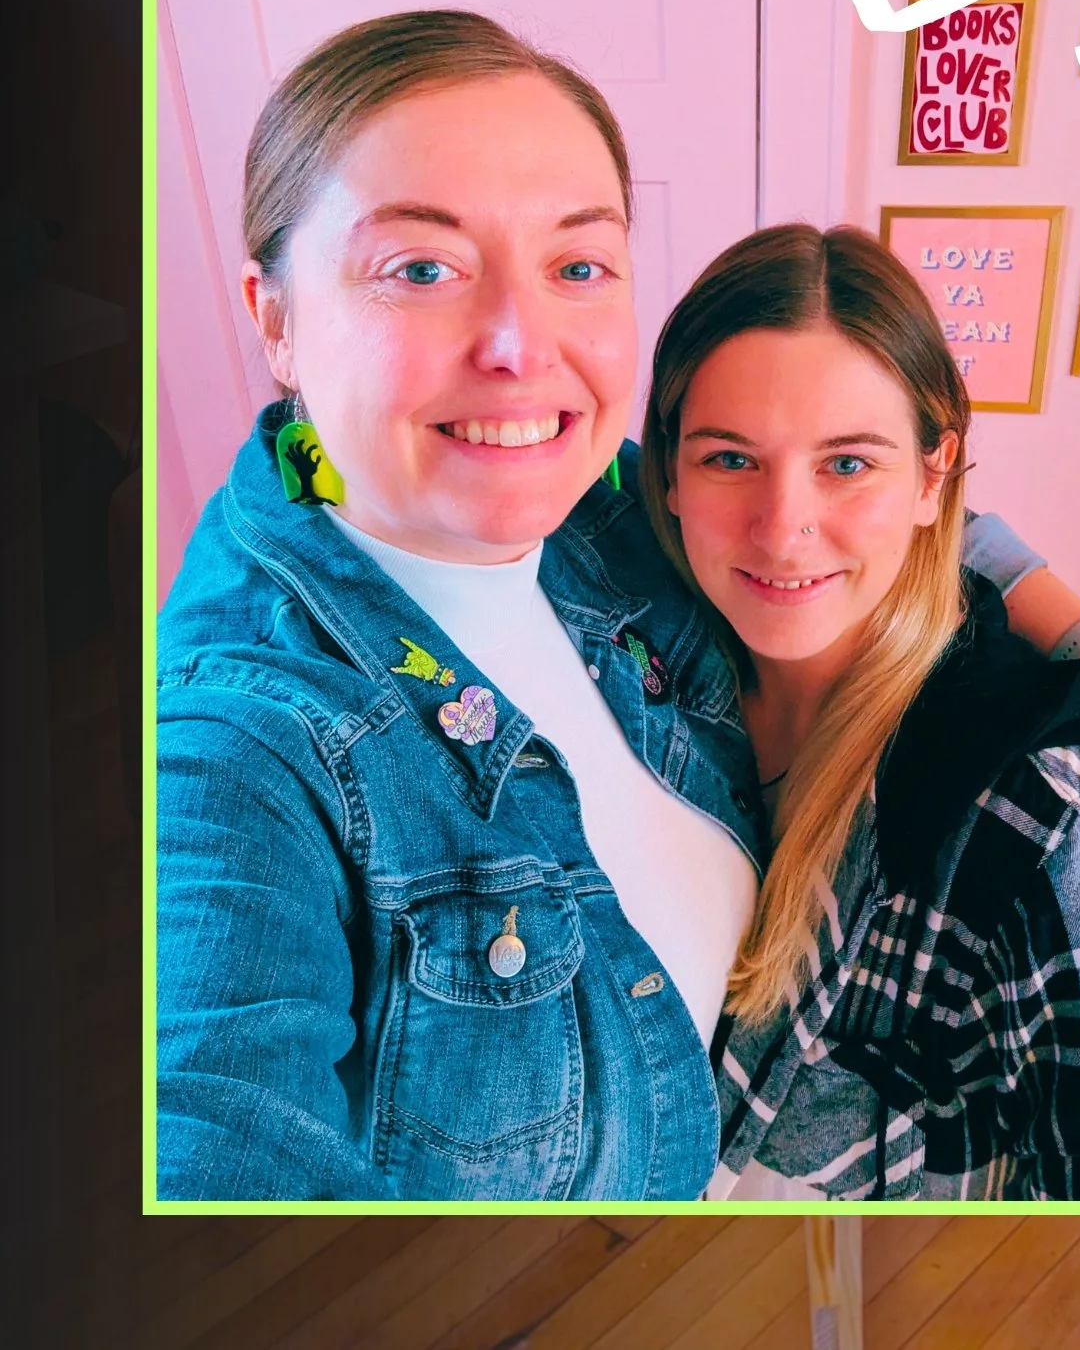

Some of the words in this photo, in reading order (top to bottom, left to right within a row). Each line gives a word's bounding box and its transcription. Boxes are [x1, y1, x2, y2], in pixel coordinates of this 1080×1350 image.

[922, 6, 1016, 50] BOOKS
[919, 48, 1011, 103] LOVER
[916, 100, 1007, 150] CLUB
[920, 247, 1014, 271] LOVE
[941, 283, 984, 307] YA
[944, 321, 1010, 343] EAN
